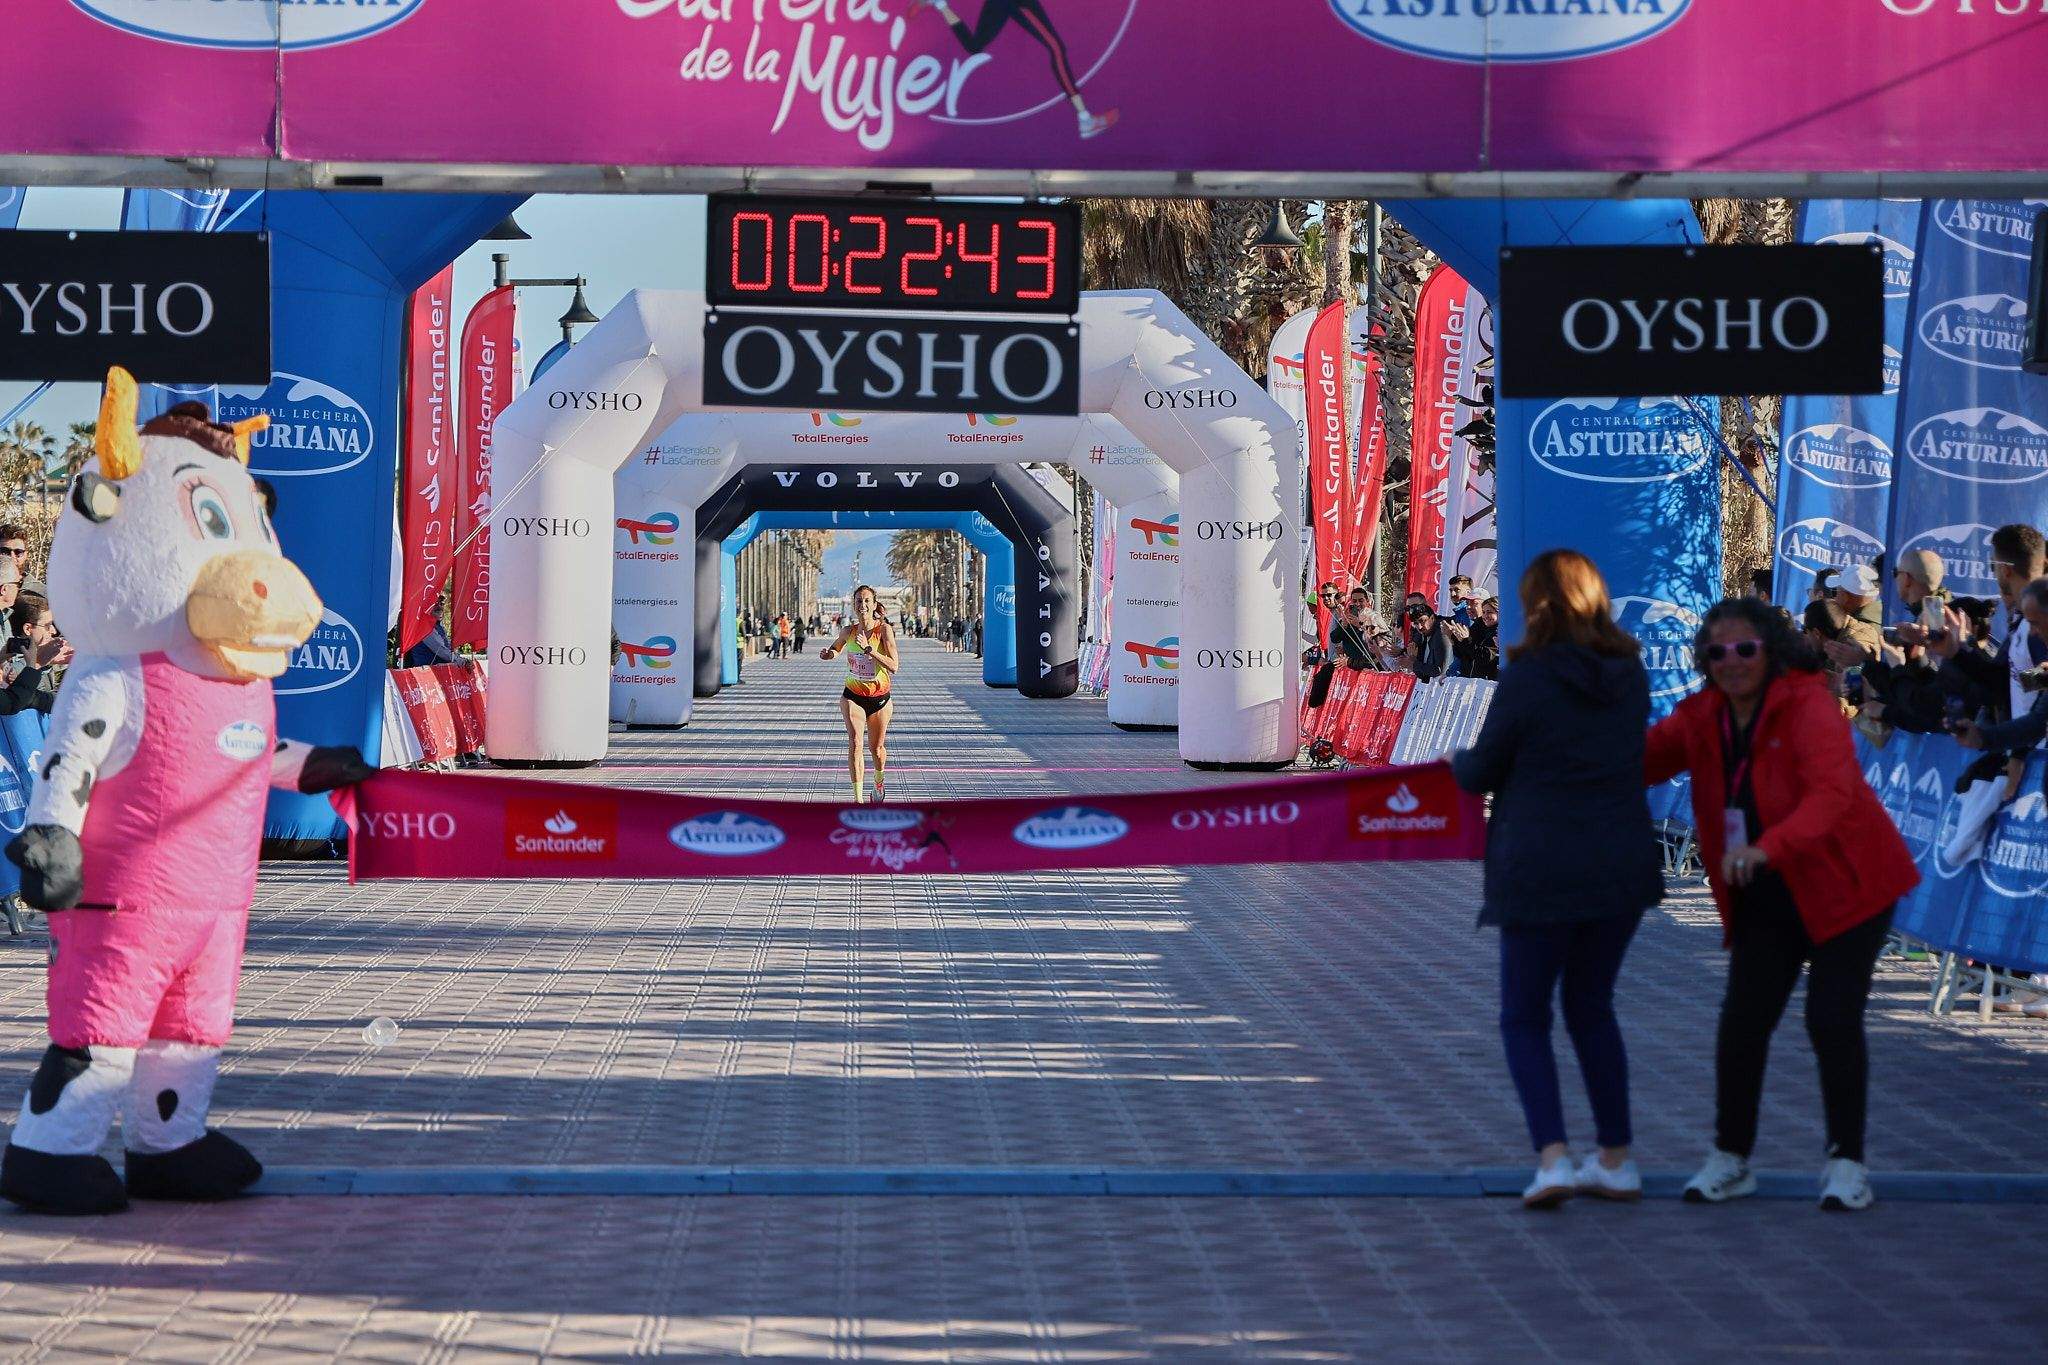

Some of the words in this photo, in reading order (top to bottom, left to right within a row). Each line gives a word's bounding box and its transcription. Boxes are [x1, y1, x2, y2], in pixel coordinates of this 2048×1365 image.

[680, 24, 733, 80] de
[743, 24, 781, 81] la
[770, 16, 992, 151] Mujer
[1945, 199, 2034, 242] ASTURI
[1, 283, 214, 336] YSHO
[1562, 297, 1829, 354] OYSHO
[721, 325, 1063, 402] OYSHO
[426, 294, 446, 466] Santander
[1431, 299, 1466, 470] Santander
[548, 391, 642, 411] OYSHO
[1144, 389, 1237, 409] OYSHO
[293, 409, 357, 423] LECHERA
[1319, 351, 1341, 493] Santander
[1571, 416, 1639, 426] CENTRAL
[250, 423, 362, 454] URIANA
[792, 433, 869, 445] TotalEnergies
[947, 433, 1024, 444] TotalEnergies
[1916, 429, 2048, 467] ASTURIANA
[1793, 439, 1891, 478] ASTURIANA
[773, 471, 960, 488] VOLVO
[504, 517, 590, 537] OYSHO
[1197, 521, 1283, 540] OYSHO
[615, 551, 679, 562] TotalEnergies
[1129, 551, 1179, 563] TotalEnerg
[1038, 545, 1052, 679] VOLVO
[500, 645, 586, 666] OYSHO
[1197, 649, 1283, 668] OYSHO
[612, 674, 676, 686] TotalEnergies
[1123, 674, 1179, 686] TotalEnergi
[1171, 801, 1299, 831] OYSHO
[1358, 813, 1448, 834] Santander
[678, 826, 776, 844] ASTURIANA
[1022, 824, 1122, 841] ASTURIANA
[515, 835, 605, 852] Santander
